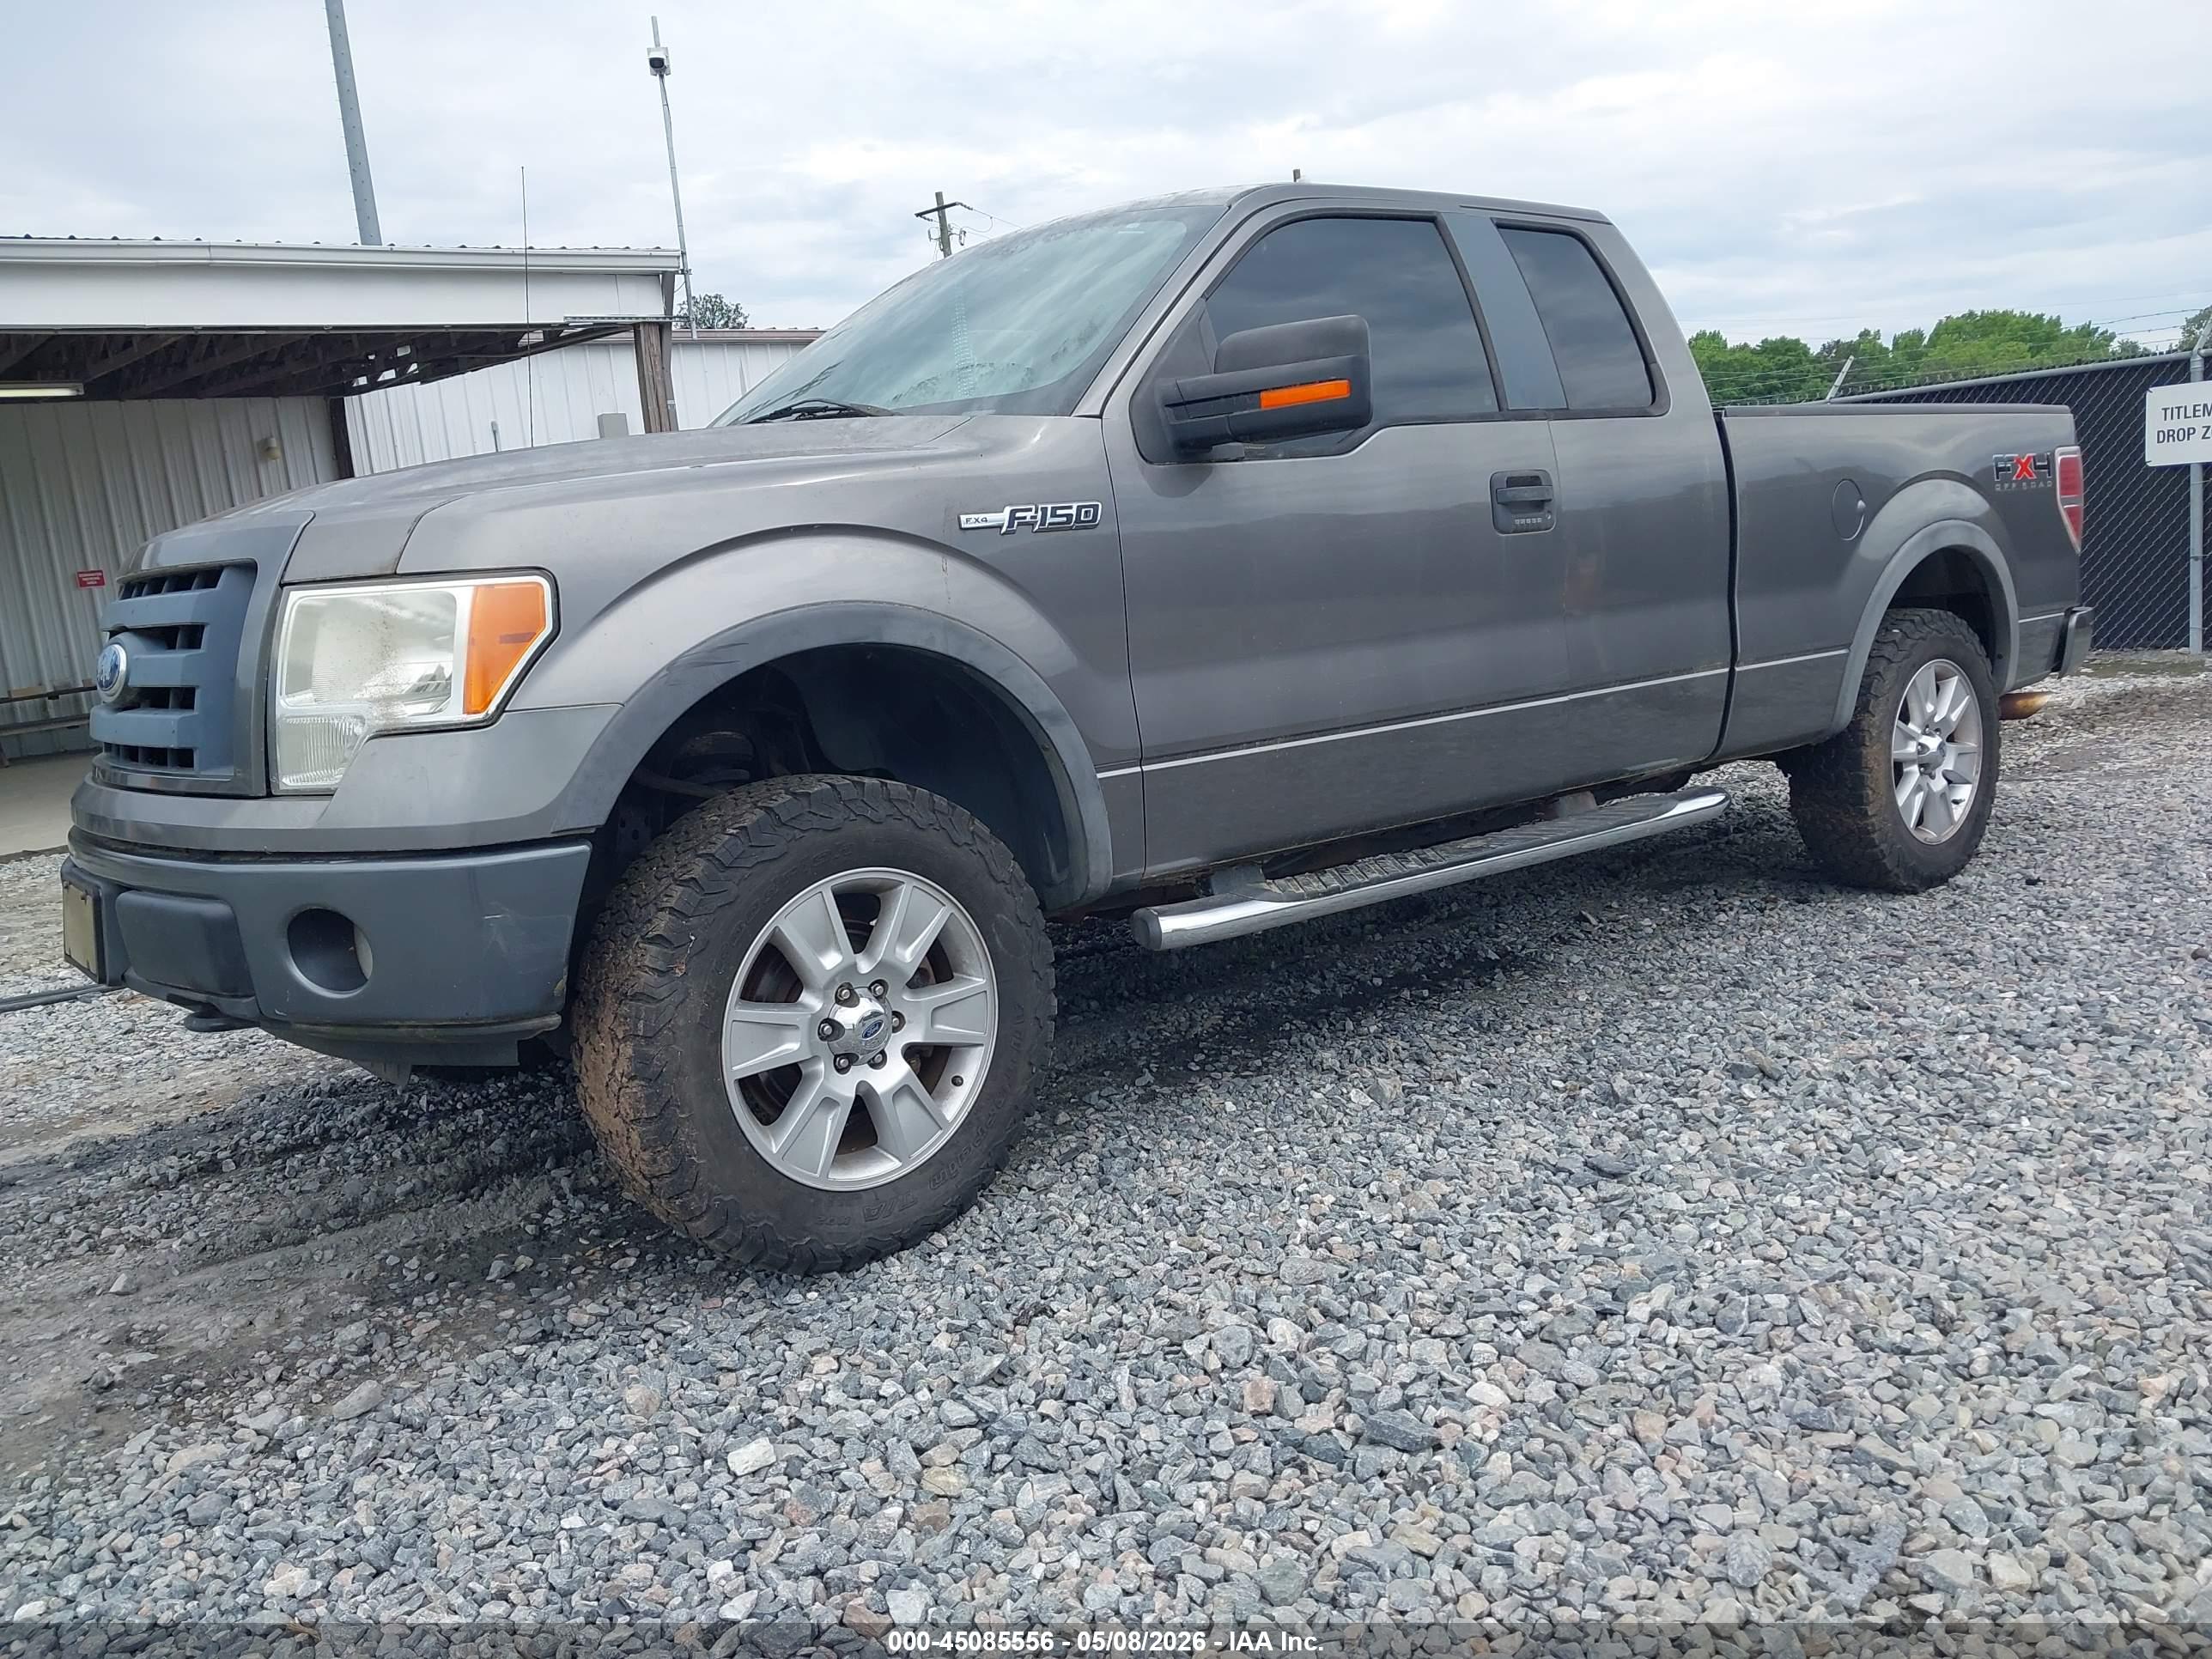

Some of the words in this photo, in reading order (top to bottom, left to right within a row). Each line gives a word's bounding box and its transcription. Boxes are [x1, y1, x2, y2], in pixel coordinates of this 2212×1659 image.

[2161, 403, 2212, 421] TITLEM
[2156, 427, 2197, 444] DROP
[2201, 425, 2212, 440] Z
[1992, 453, 2052, 481] FX4
[1000, 501, 1103, 535] F-150
